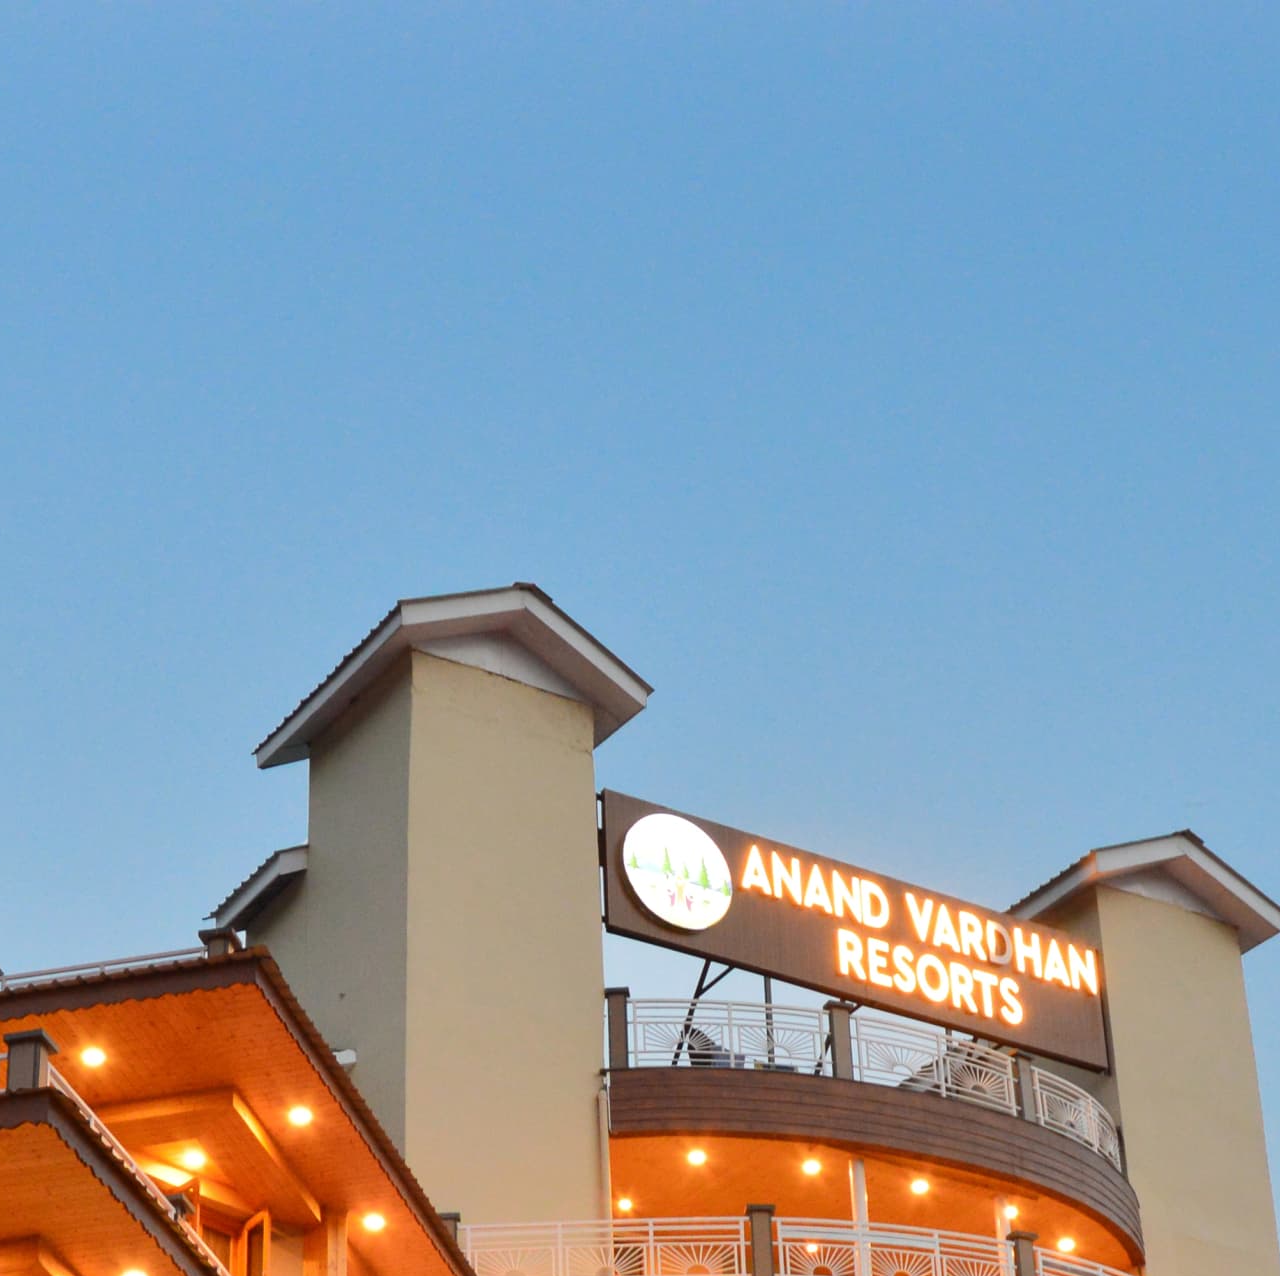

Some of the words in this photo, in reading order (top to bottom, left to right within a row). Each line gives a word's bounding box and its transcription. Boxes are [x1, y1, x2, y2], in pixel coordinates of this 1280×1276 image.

[742, 844, 889, 929] ANAND
[905, 891, 1098, 995] VARDHAN
[837, 929, 1024, 1026] RESORTS
